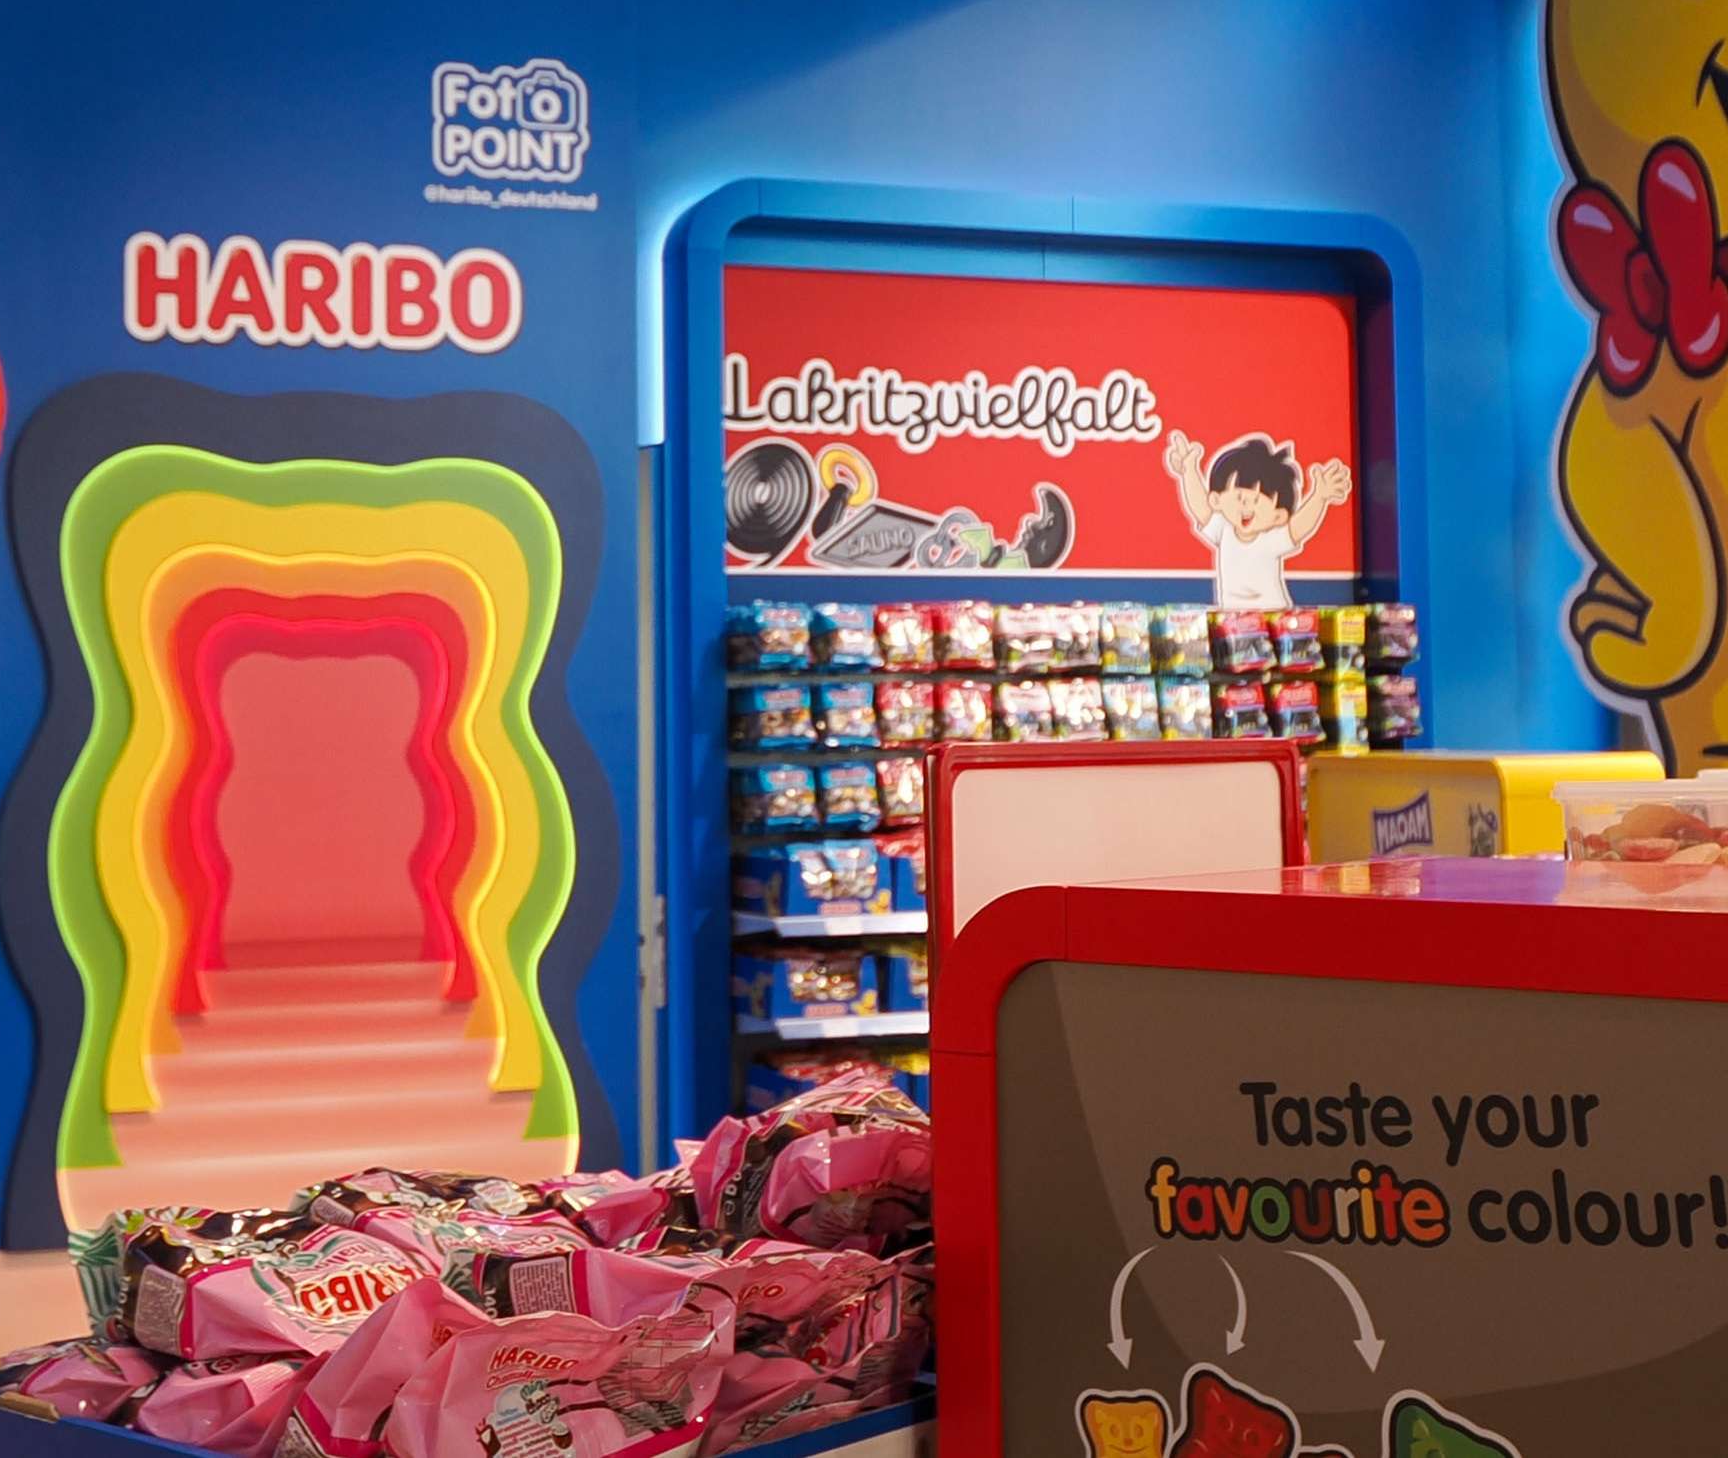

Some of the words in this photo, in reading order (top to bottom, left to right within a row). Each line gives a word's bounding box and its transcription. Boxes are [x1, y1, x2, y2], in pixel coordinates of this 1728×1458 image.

[444, 73, 562, 123] Foto
[443, 124, 579, 171] POINT
[133, 241, 513, 344] HARIBO
[724, 360, 1158, 450] Lakritzvielfalt
[1376, 800, 1432, 855] MAOAM
[1239, 1081, 1413, 1148] Taste
[1431, 1093, 1599, 1167] your
[1146, 1158, 1451, 1246] favourite
